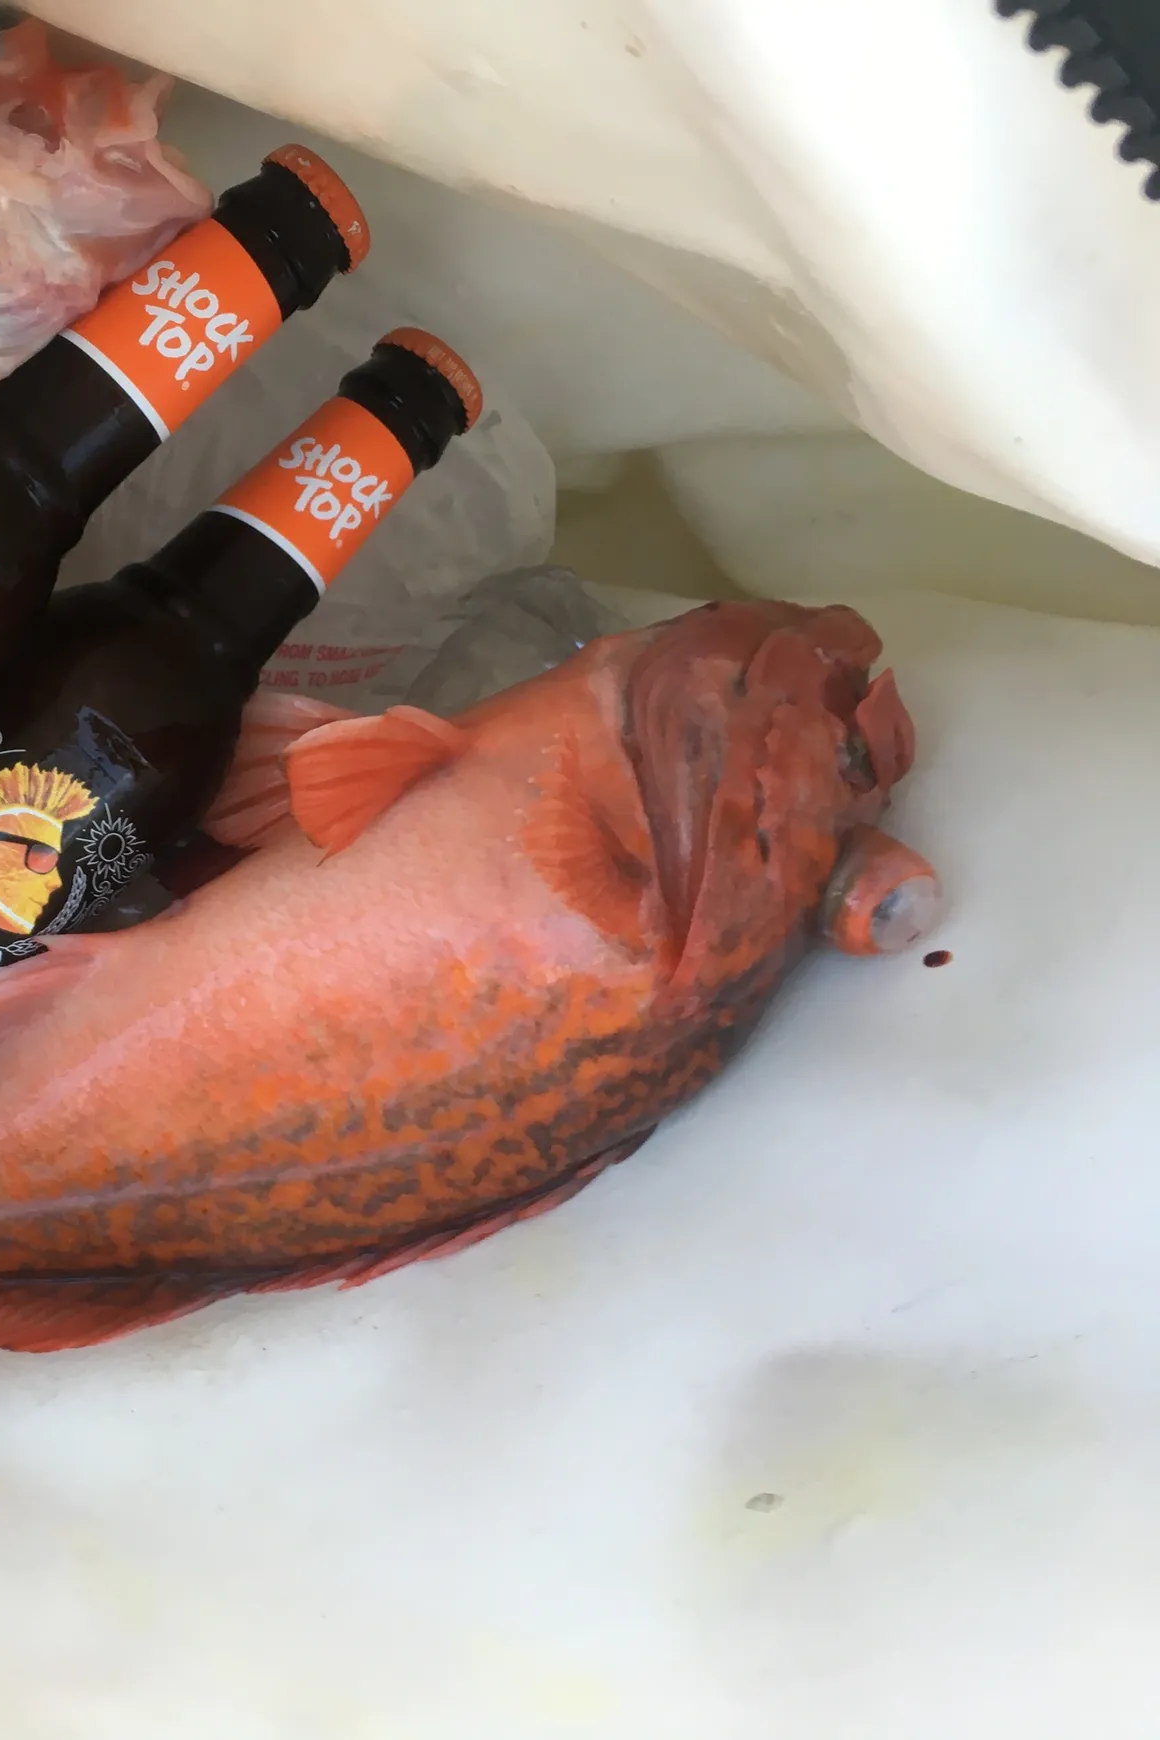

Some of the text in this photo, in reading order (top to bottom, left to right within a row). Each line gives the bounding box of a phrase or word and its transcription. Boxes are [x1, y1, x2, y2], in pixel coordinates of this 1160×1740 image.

[132, 260, 253, 362] SHOCK
[278, 437, 392, 518] SHOCK
[277, 644, 313, 660] ROM
